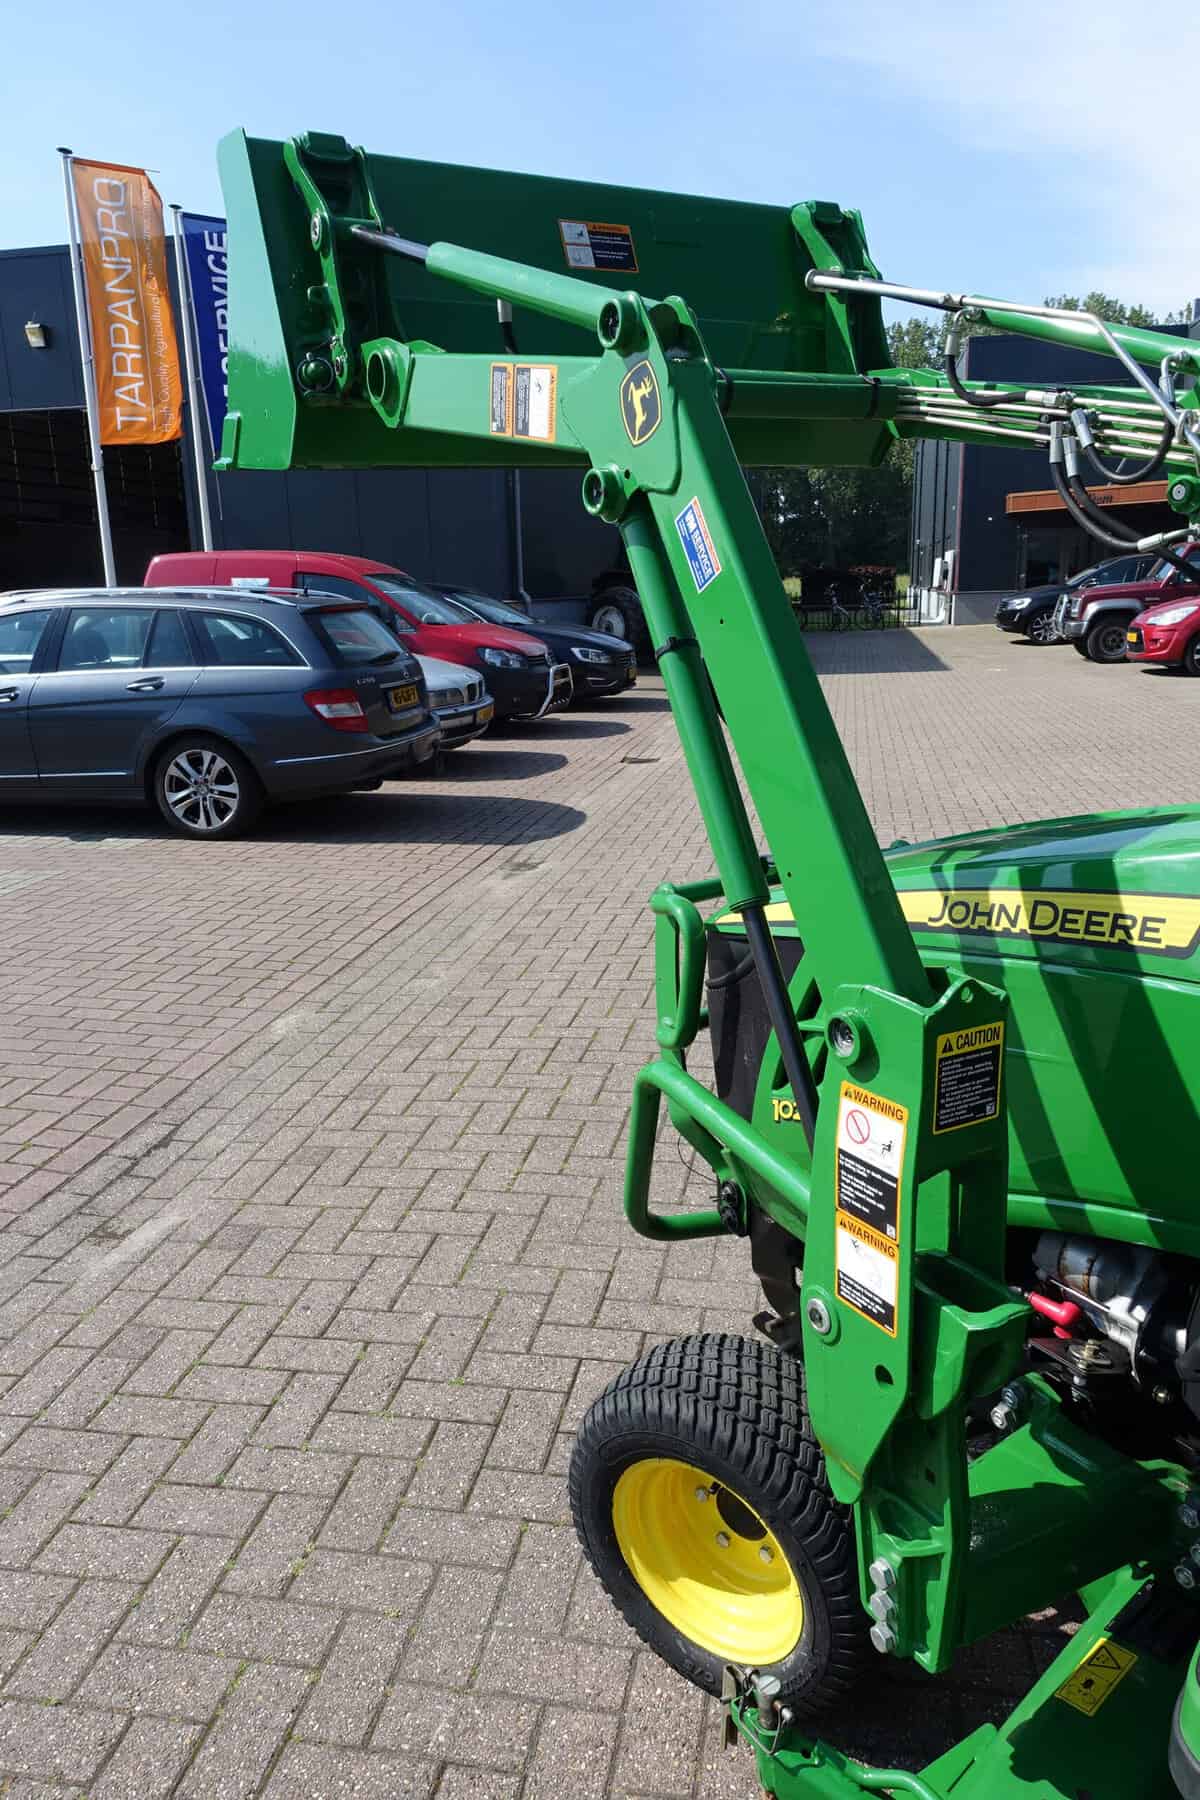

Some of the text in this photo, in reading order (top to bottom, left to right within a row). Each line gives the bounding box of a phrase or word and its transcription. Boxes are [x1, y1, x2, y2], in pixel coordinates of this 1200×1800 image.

[94, 177, 147, 432] TARPANPRO
[928, 894, 1168, 945] JOHN DEERE
[956, 1026, 1001, 1050] CAUTION
[853, 1090, 904, 1123] WARNING
[847, 1222, 896, 1259] WARNING
